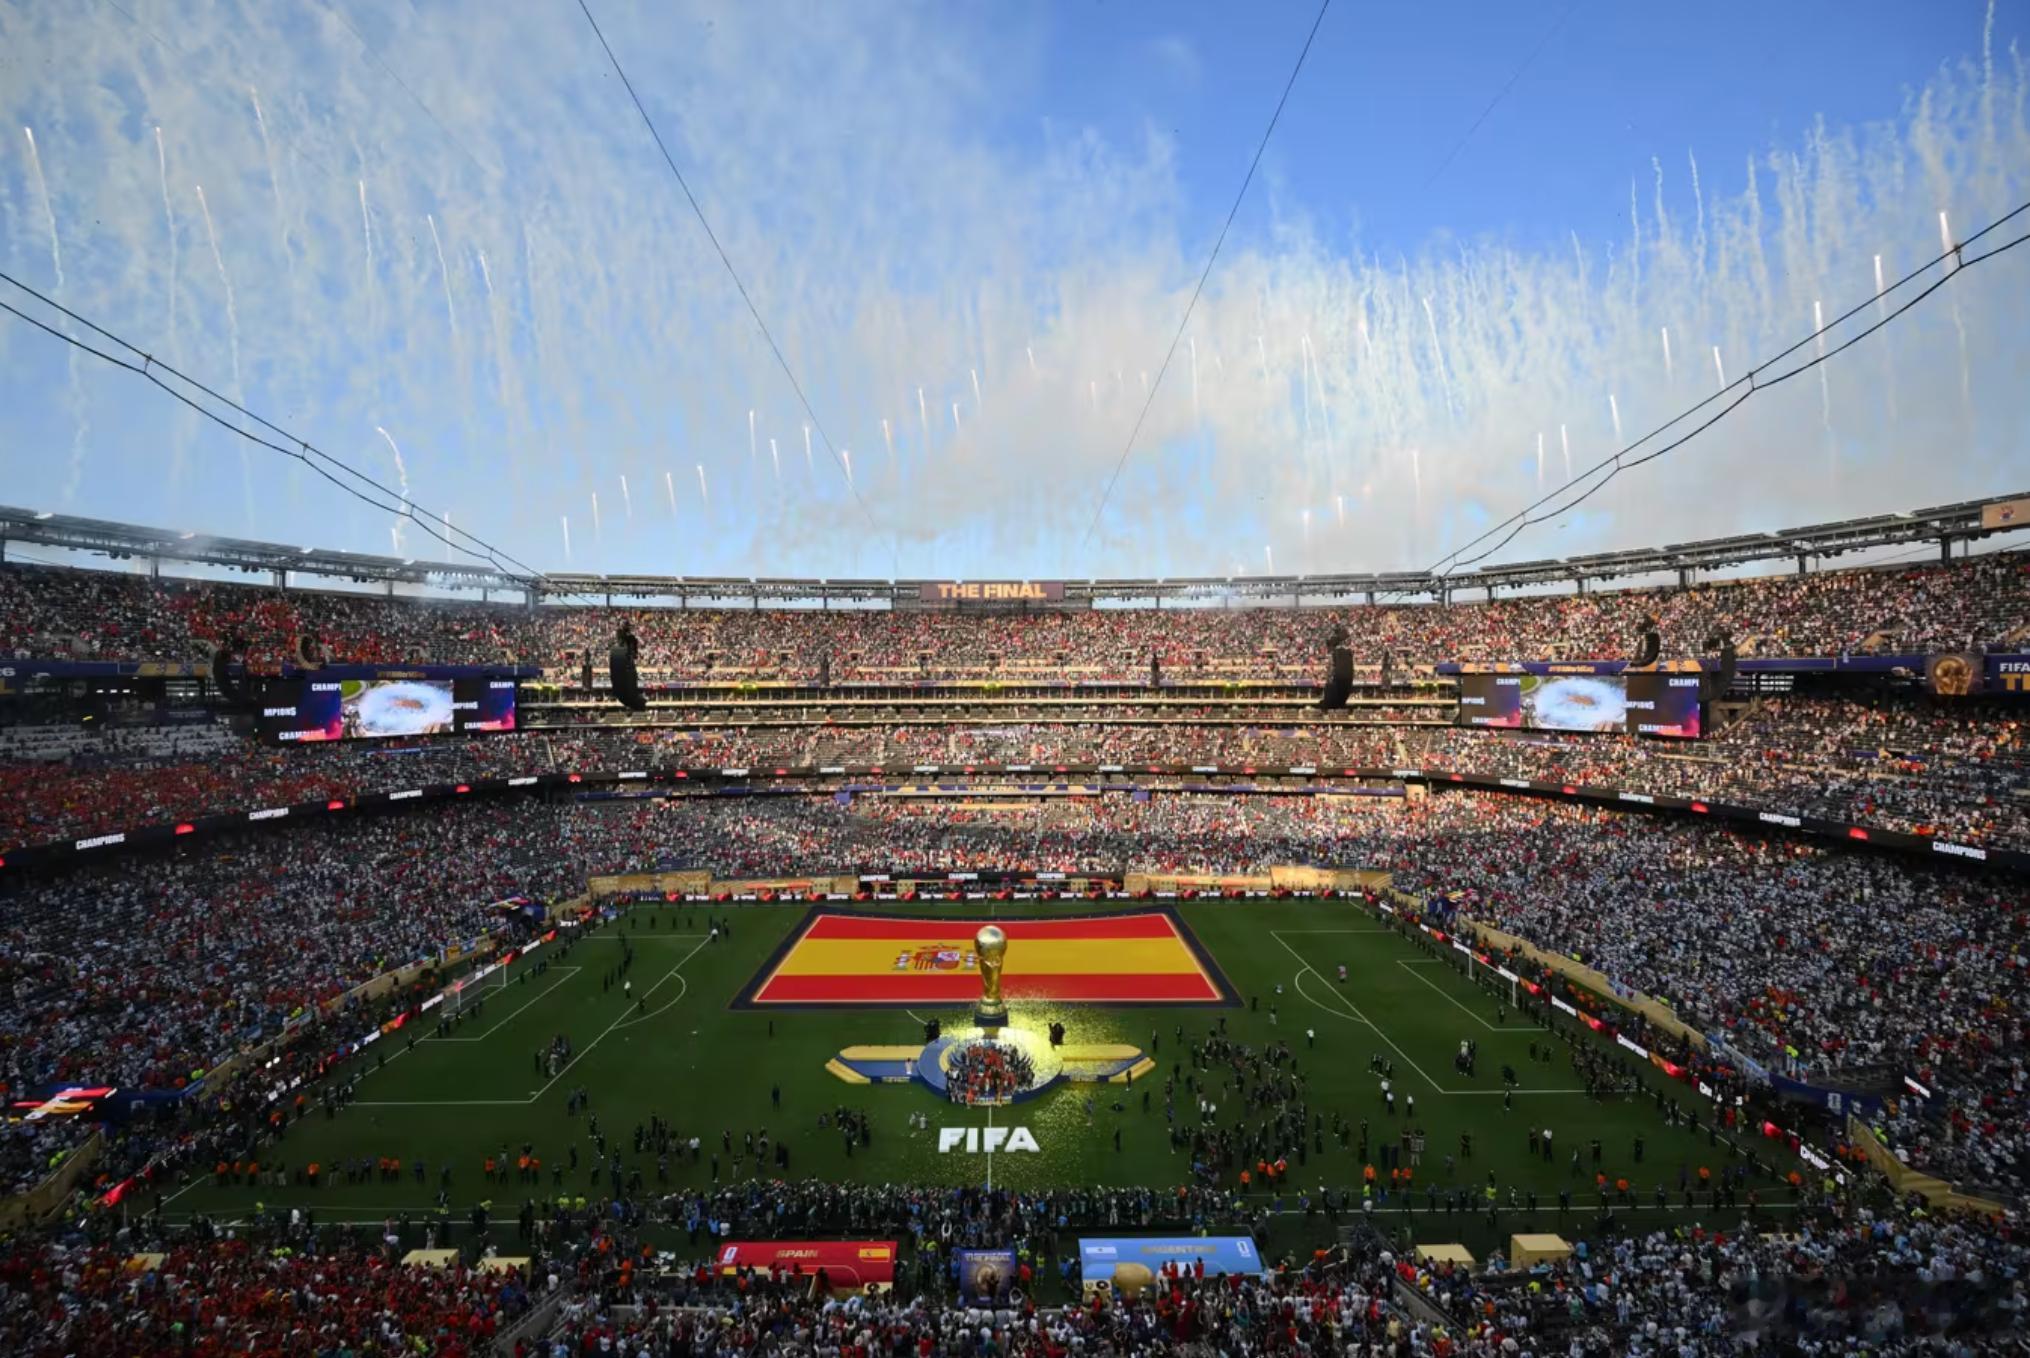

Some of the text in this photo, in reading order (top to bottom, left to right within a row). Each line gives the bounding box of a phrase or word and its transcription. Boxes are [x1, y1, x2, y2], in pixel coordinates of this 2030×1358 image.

[938, 584, 1047, 598] THE FINAL
[76, 834, 124, 849] CHAMPIONS
[1933, 842, 1986, 860] CHAMPIONS
[938, 1127, 1040, 1153] FIFA
[776, 1250, 818, 1258] SPAIN
